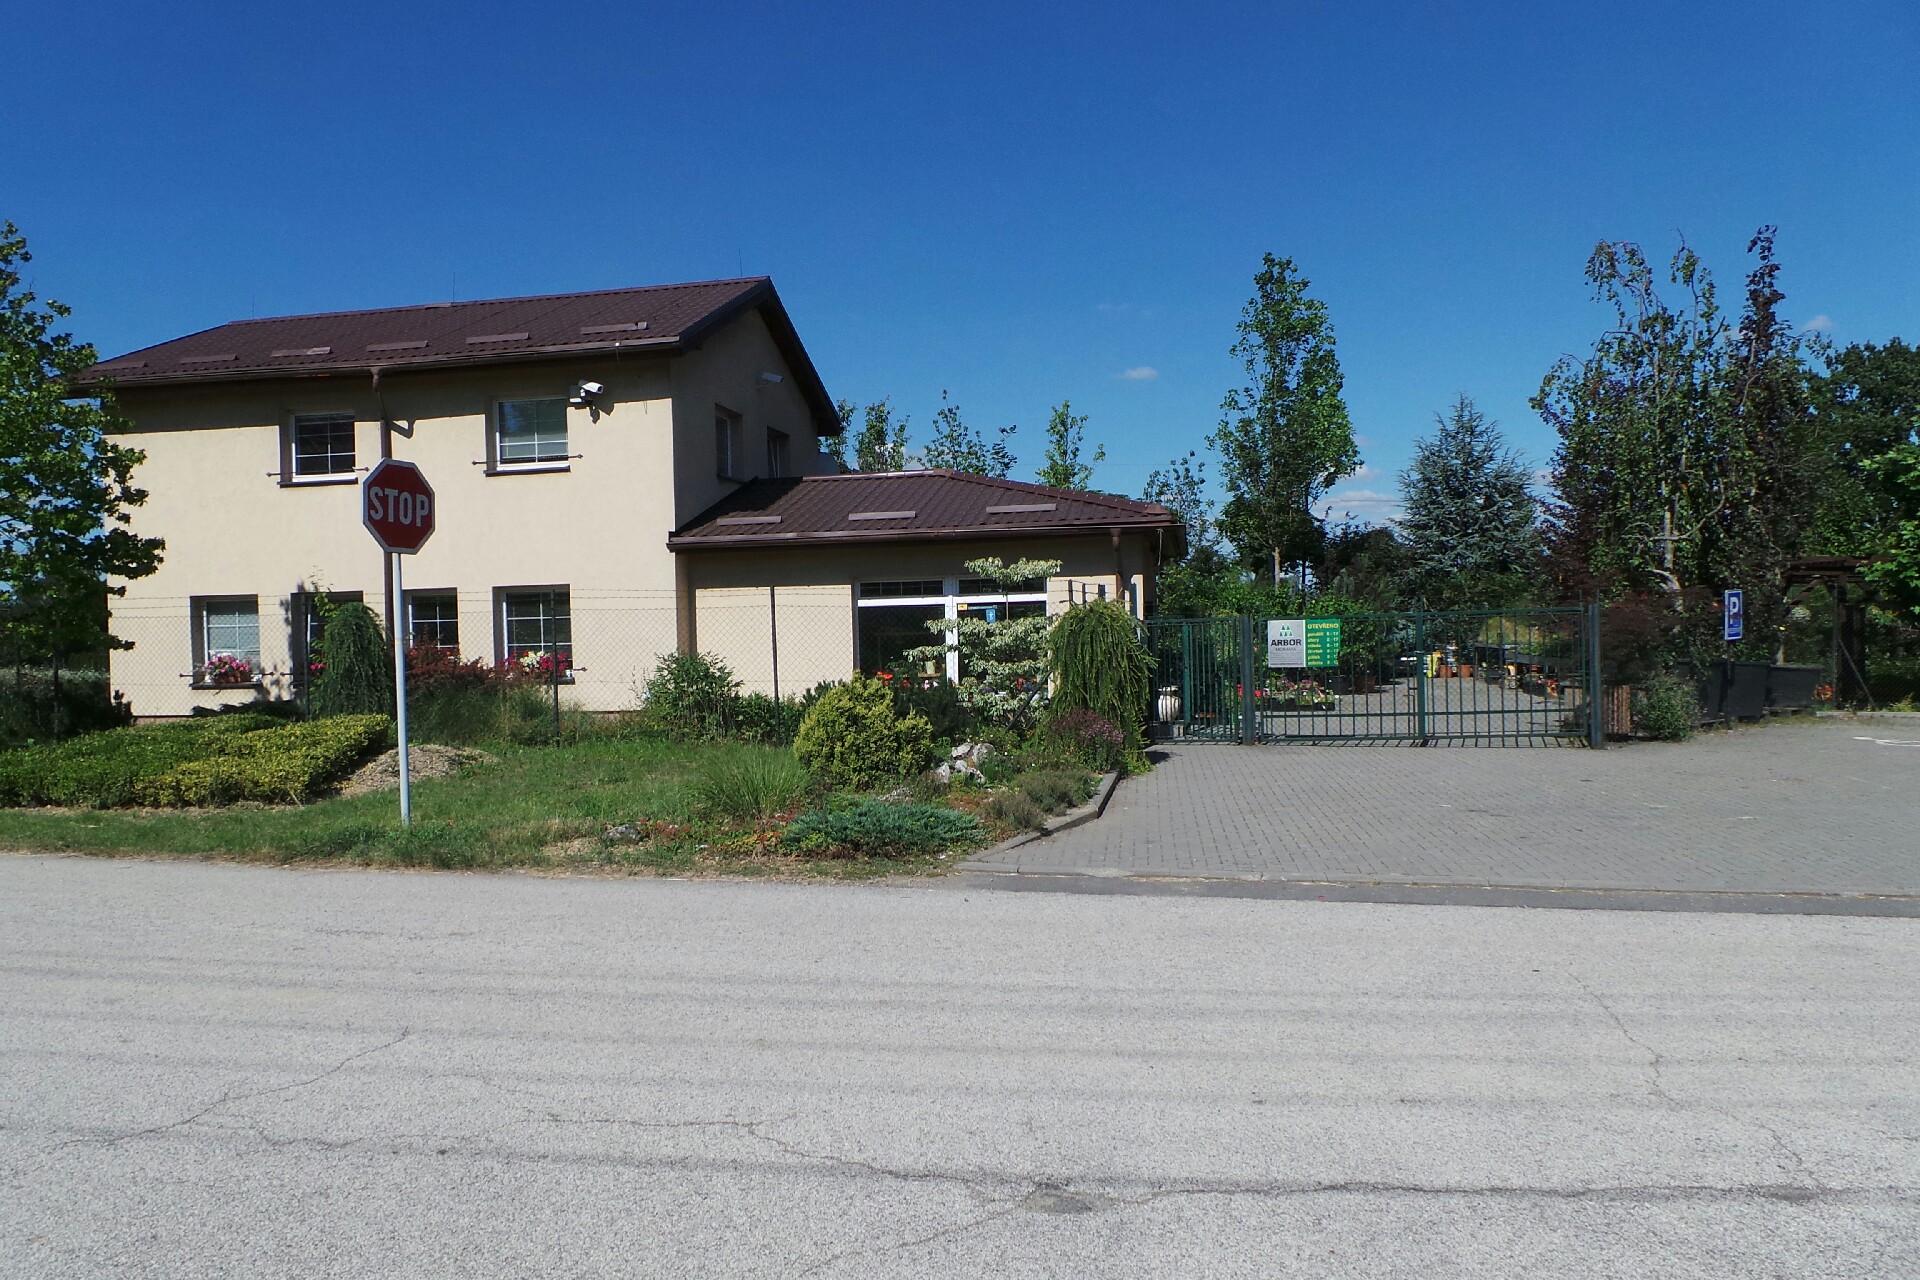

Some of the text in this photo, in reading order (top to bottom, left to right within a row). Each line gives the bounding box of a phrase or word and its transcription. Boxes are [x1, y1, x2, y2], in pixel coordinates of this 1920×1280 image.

[369, 486, 429, 527] STOP
[1730, 597, 1739, 624] P
[1270, 638, 1302, 646] ARBOR
